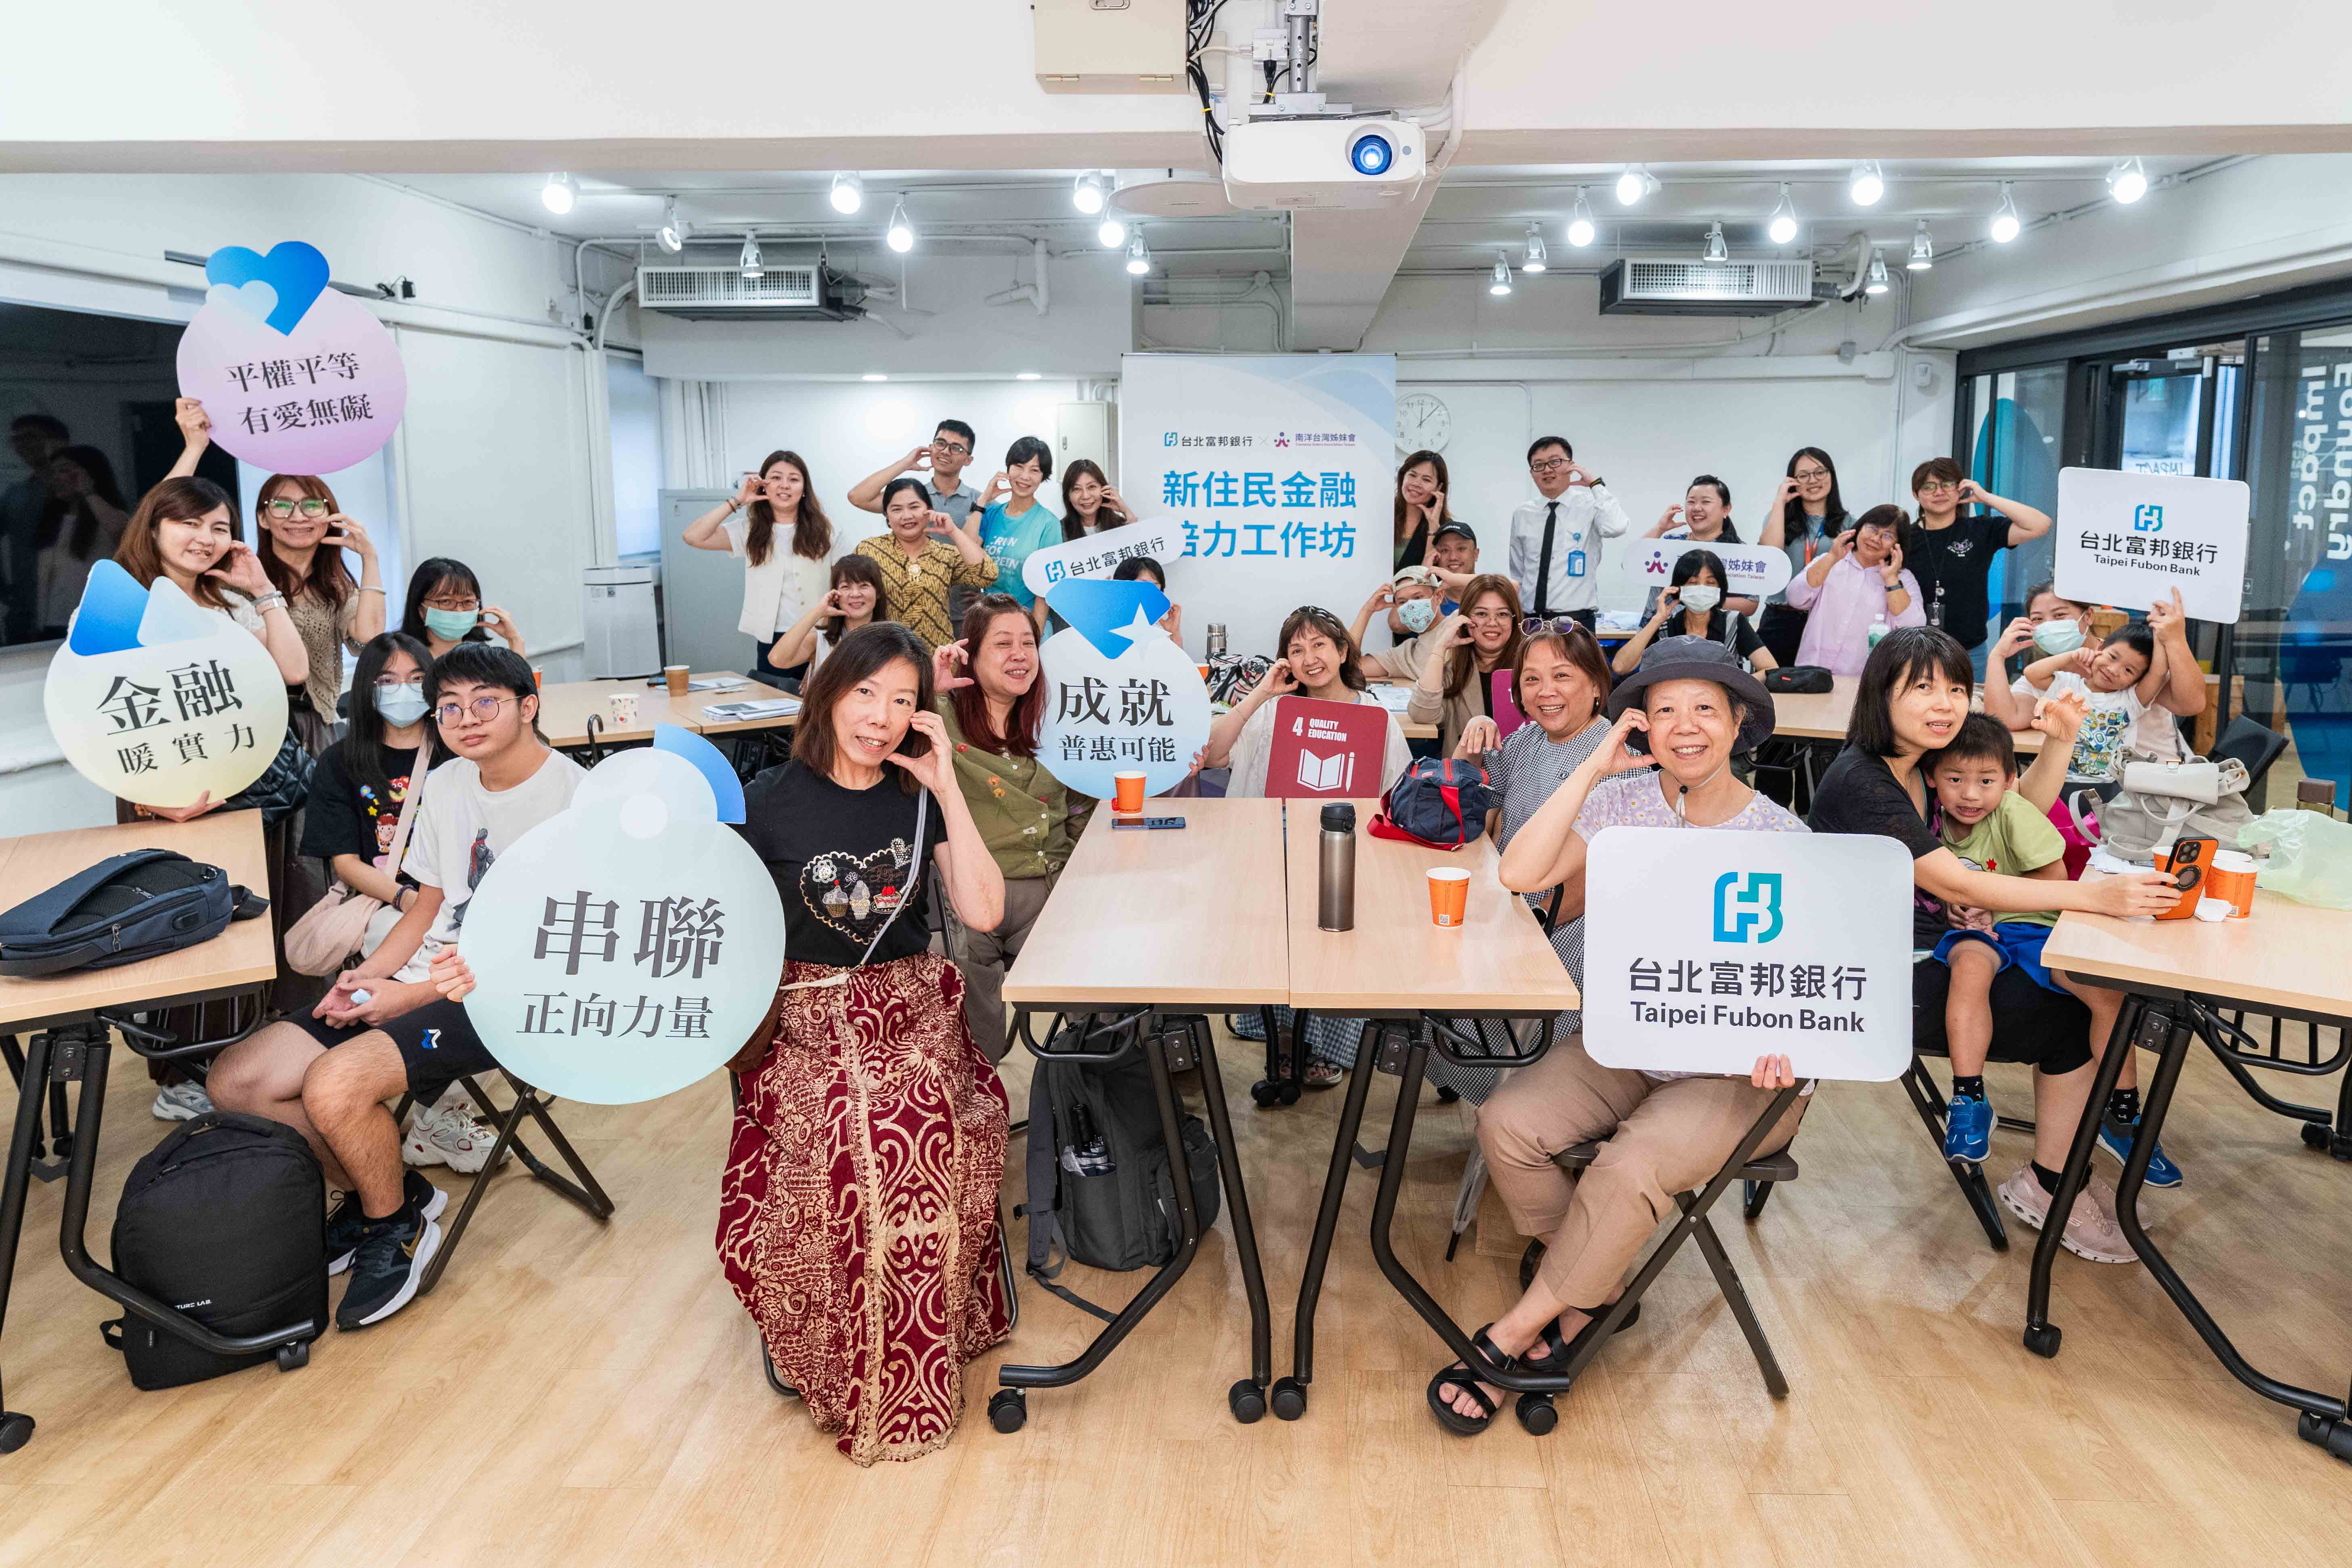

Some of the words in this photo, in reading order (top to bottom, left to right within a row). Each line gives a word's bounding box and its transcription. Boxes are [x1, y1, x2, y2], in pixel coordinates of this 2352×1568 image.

[225, 353, 360, 392] 平權平等
[237, 394, 373, 435] 有愛無礙
[1181, 436, 1253, 447] 台北富邦銀行
[1295, 433, 1356, 442] 南洋台灣姊妹會
[1163, 470, 1356, 508] 新住民金融
[1070, 537, 1164, 576] 台北富邦銀行
[2081, 531, 2218, 564] 台北富邦銀行
[2094, 554, 2128, 567] Taipei
[2131, 558, 2167, 571] Fubon
[2170, 563, 2201, 576] Bank
[96, 659, 243, 735] 金融
[1056, 676, 1174, 726] 成就
[1292, 717, 1303, 736] 4
[1308, 728, 1347, 742] EDUCATION
[1309, 718, 1339, 730] QUALITY
[117, 723, 255, 775] 暖實力
[1058, 734, 1177, 762] 普惠可能
[533, 890, 726, 979] 串聯
[1630, 957, 1867, 1001] 台北富邦銀行
[516, 991, 714, 1038] 正向力量
[1630, 1001, 1706, 1028] Taipei
[1714, 1005, 1793, 1029] Fubon
[1800, 1009, 1865, 1032] Bank
